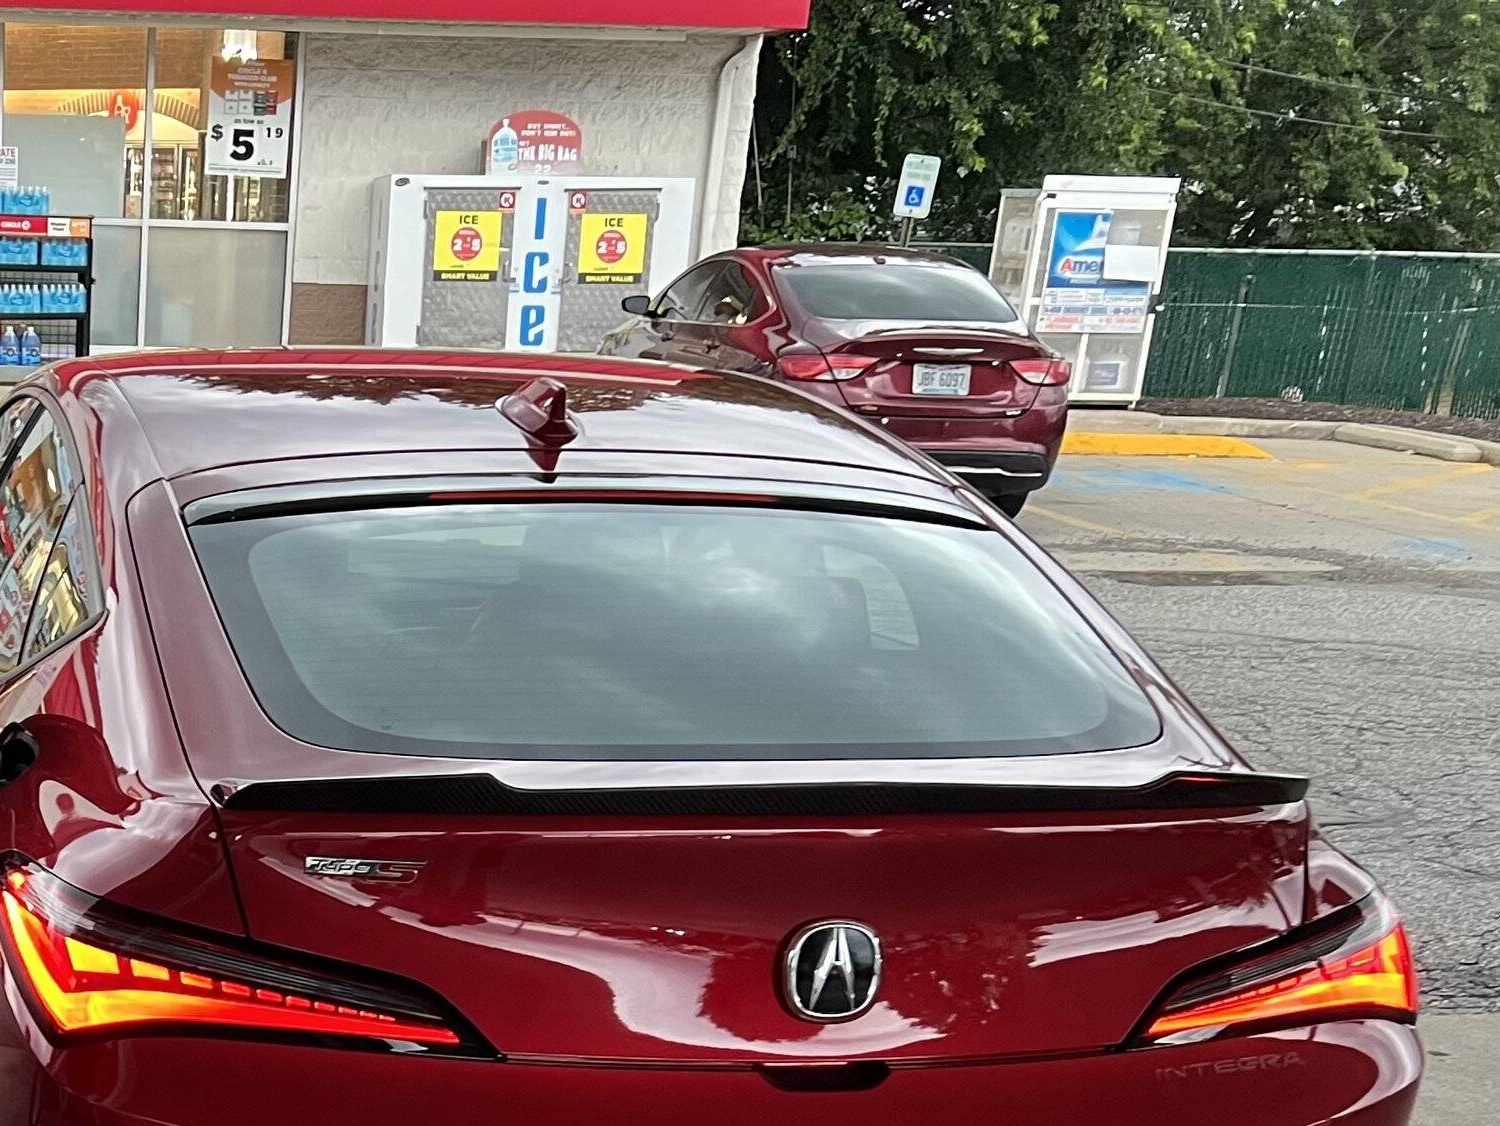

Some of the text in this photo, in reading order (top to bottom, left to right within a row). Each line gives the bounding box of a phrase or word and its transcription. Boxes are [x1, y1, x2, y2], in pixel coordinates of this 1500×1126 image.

[229, 128, 254, 161] 5
[518, 143, 577, 160] THE BIG BAG
[459, 214, 479, 225] ICE
[604, 217, 624, 228] ICE
[1059, 258, 1100, 273] Ame
[1155, 1051, 1308, 1082] INTEGRA
